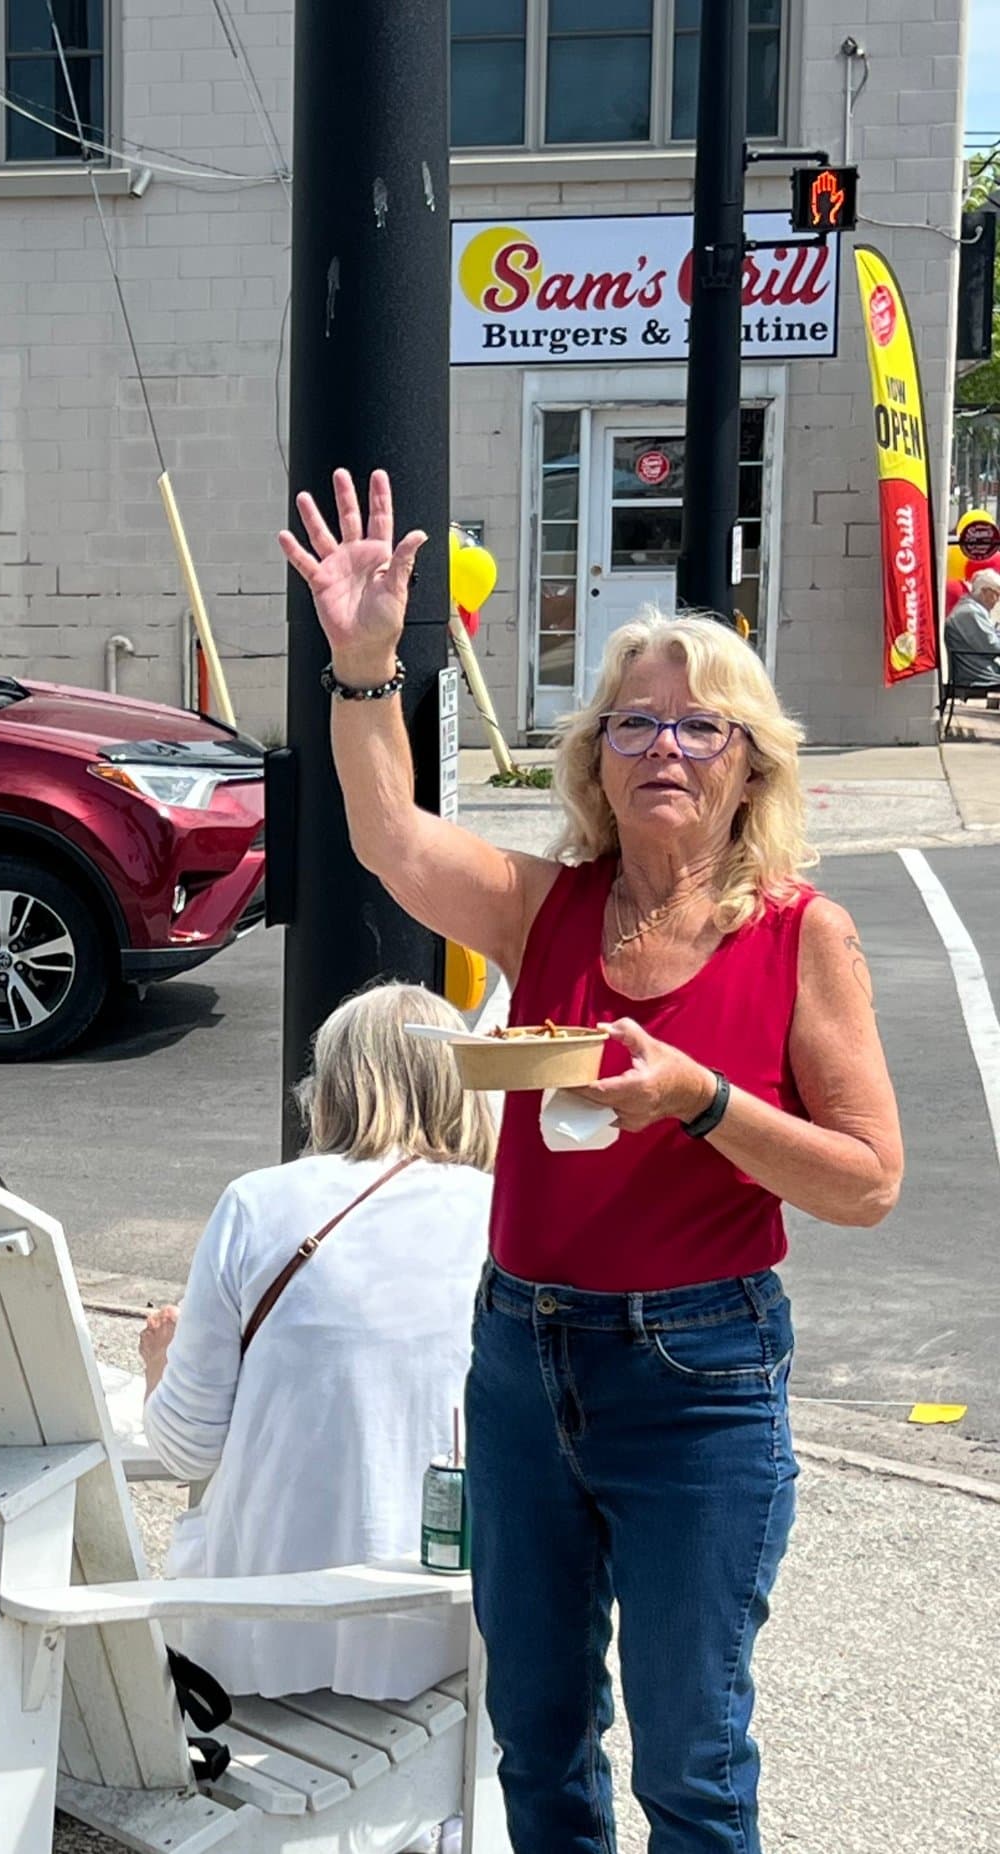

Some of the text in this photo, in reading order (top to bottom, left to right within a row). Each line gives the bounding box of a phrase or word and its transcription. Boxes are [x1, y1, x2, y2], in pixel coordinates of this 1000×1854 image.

[483, 242, 666, 313] Sam's
[482, 316, 828, 354] Burgers & utine
[875, 403, 922, 461] OPEN
[896, 504, 916, 574] Grill
